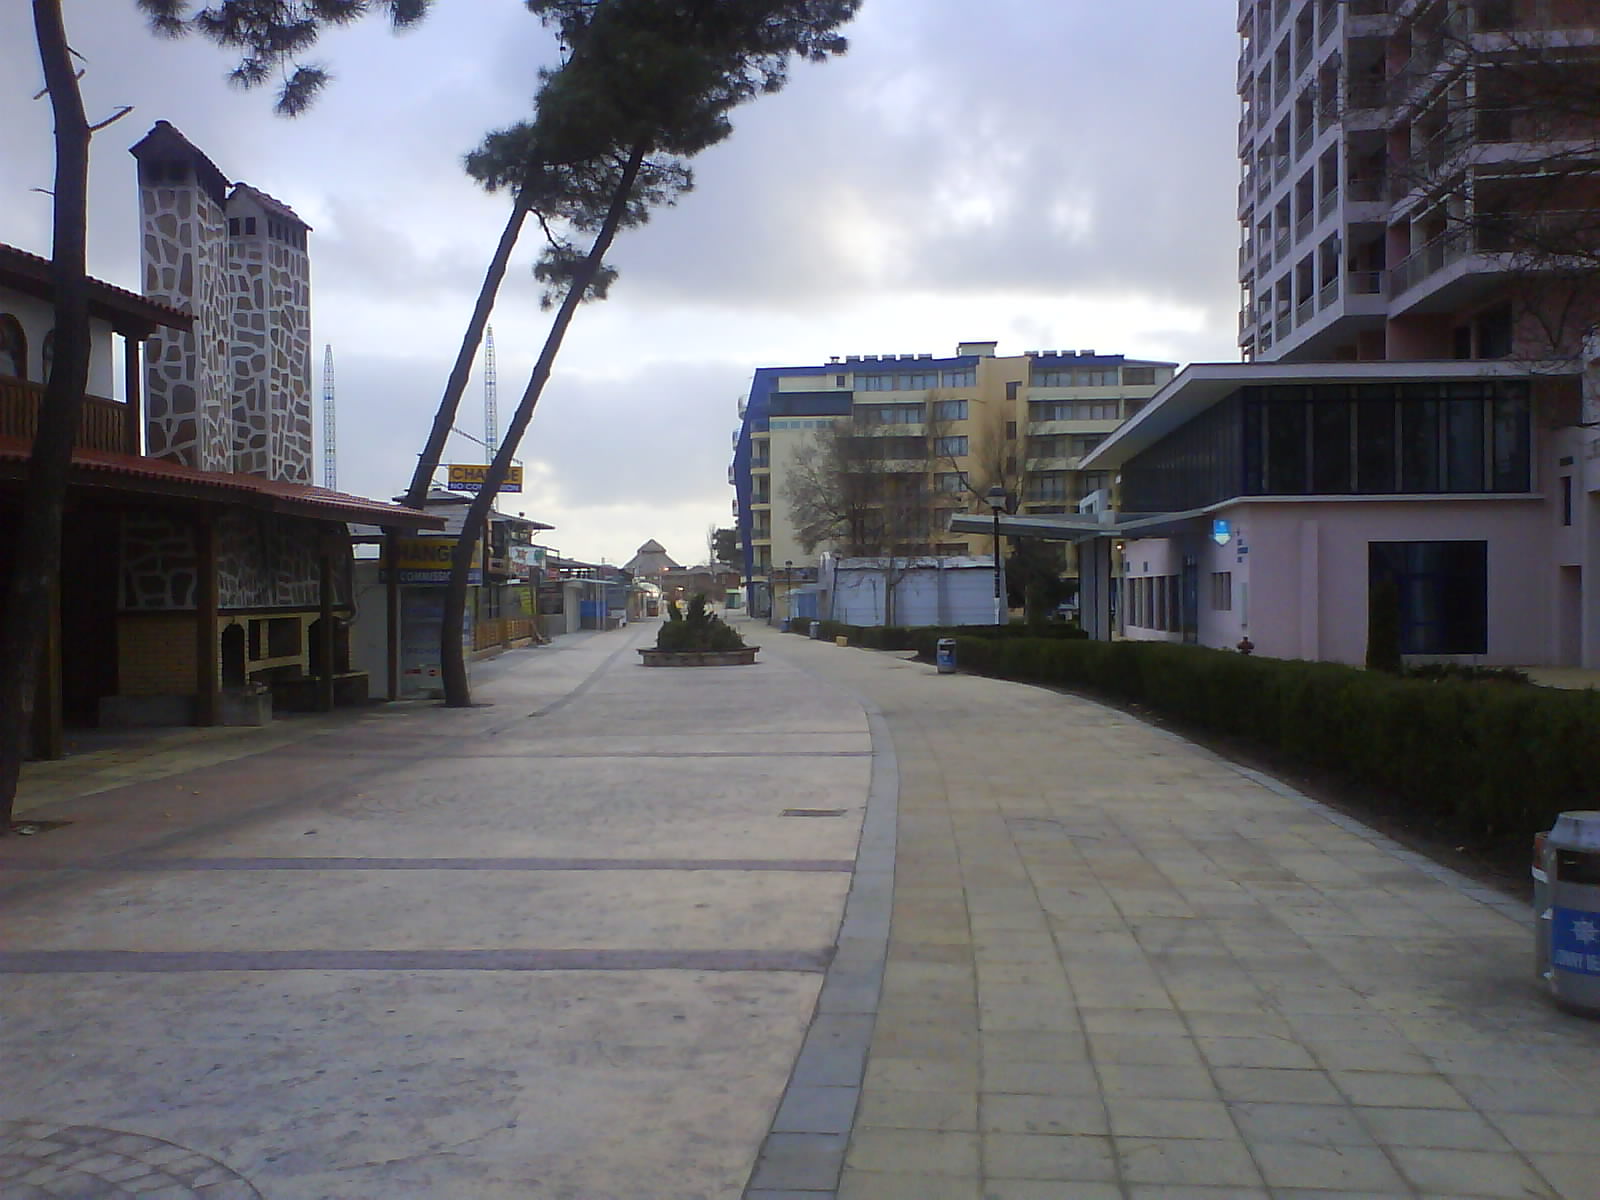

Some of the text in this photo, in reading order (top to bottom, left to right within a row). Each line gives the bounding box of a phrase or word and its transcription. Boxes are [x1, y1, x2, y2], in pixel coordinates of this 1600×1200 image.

[451, 467, 519, 482] CHAE
[450, 482, 464, 490] NO
[397, 543, 456, 561] HANG
[399, 571, 453, 582] COMMISSI
